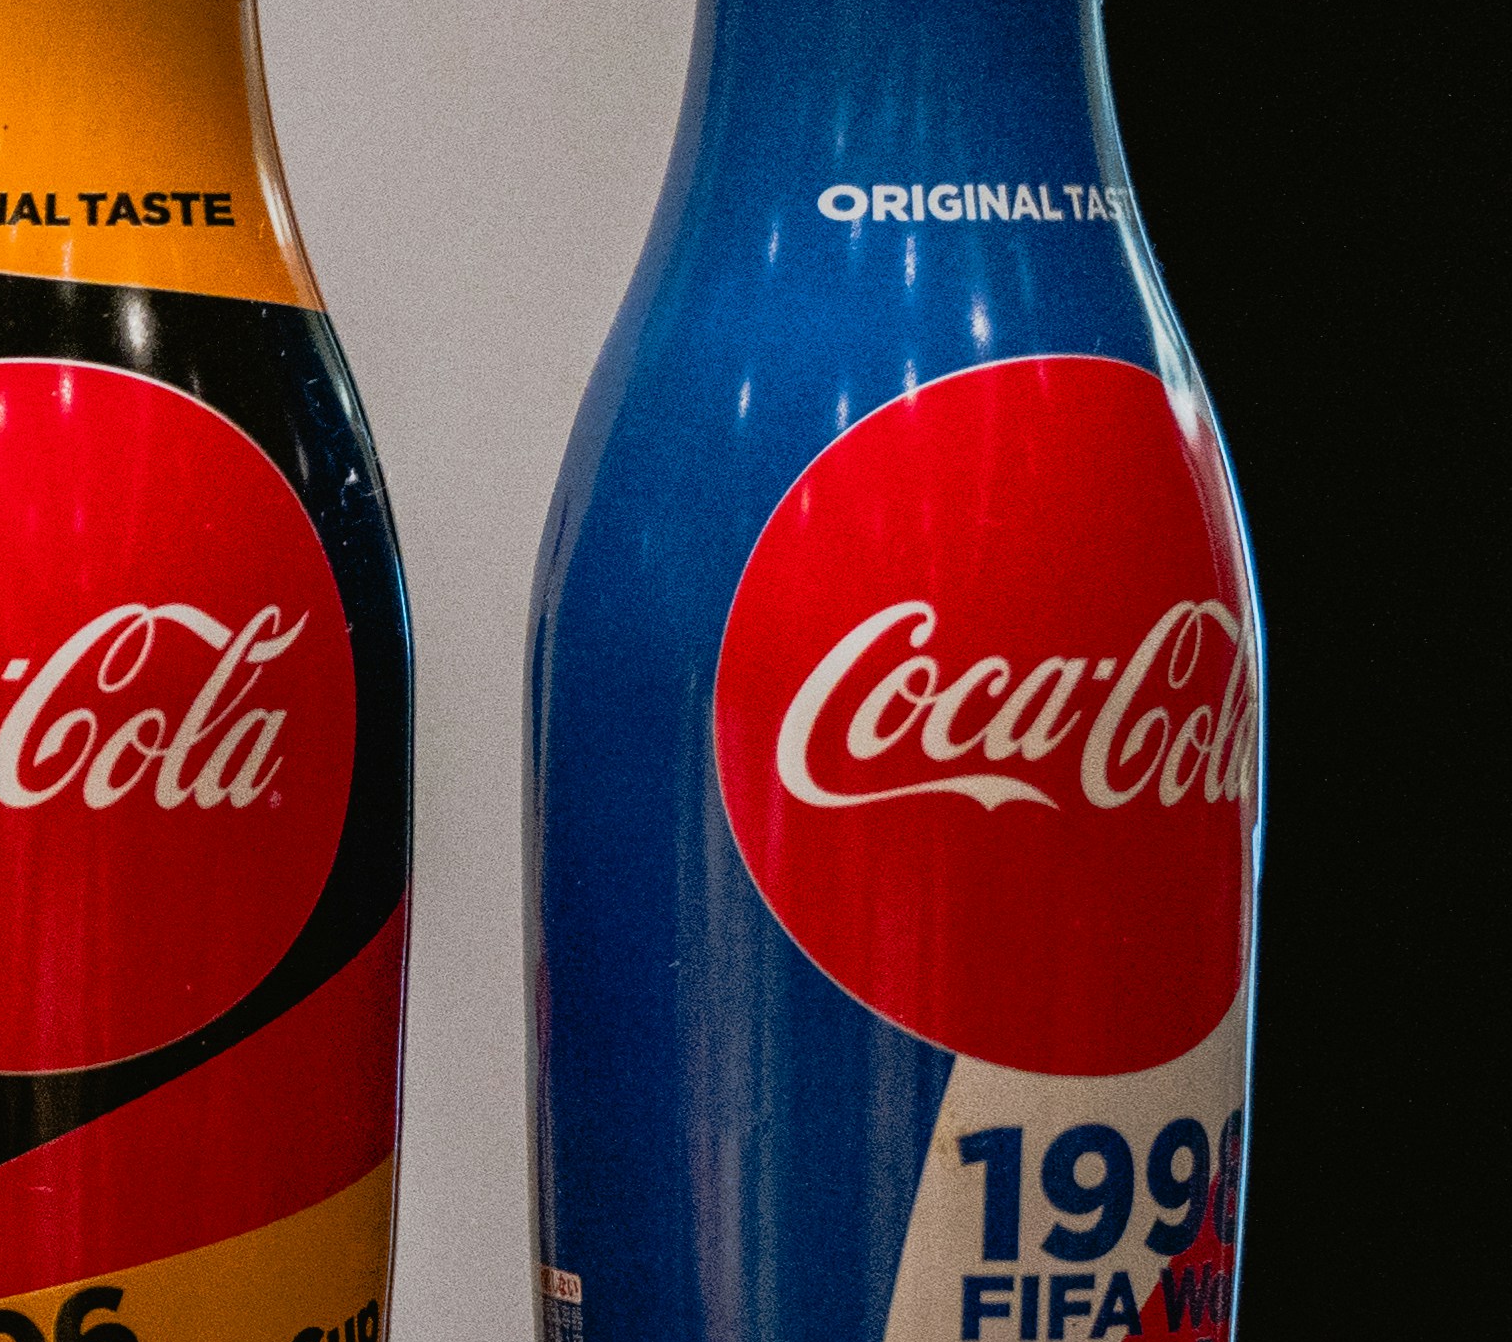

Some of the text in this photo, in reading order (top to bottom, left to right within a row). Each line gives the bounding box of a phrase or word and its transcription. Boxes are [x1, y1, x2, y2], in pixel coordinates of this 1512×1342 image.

[76, 190, 236, 227] TASTE
[816, 184, 1063, 223] ORIGINAL
[959, 1270, 1144, 1342] FIFA
